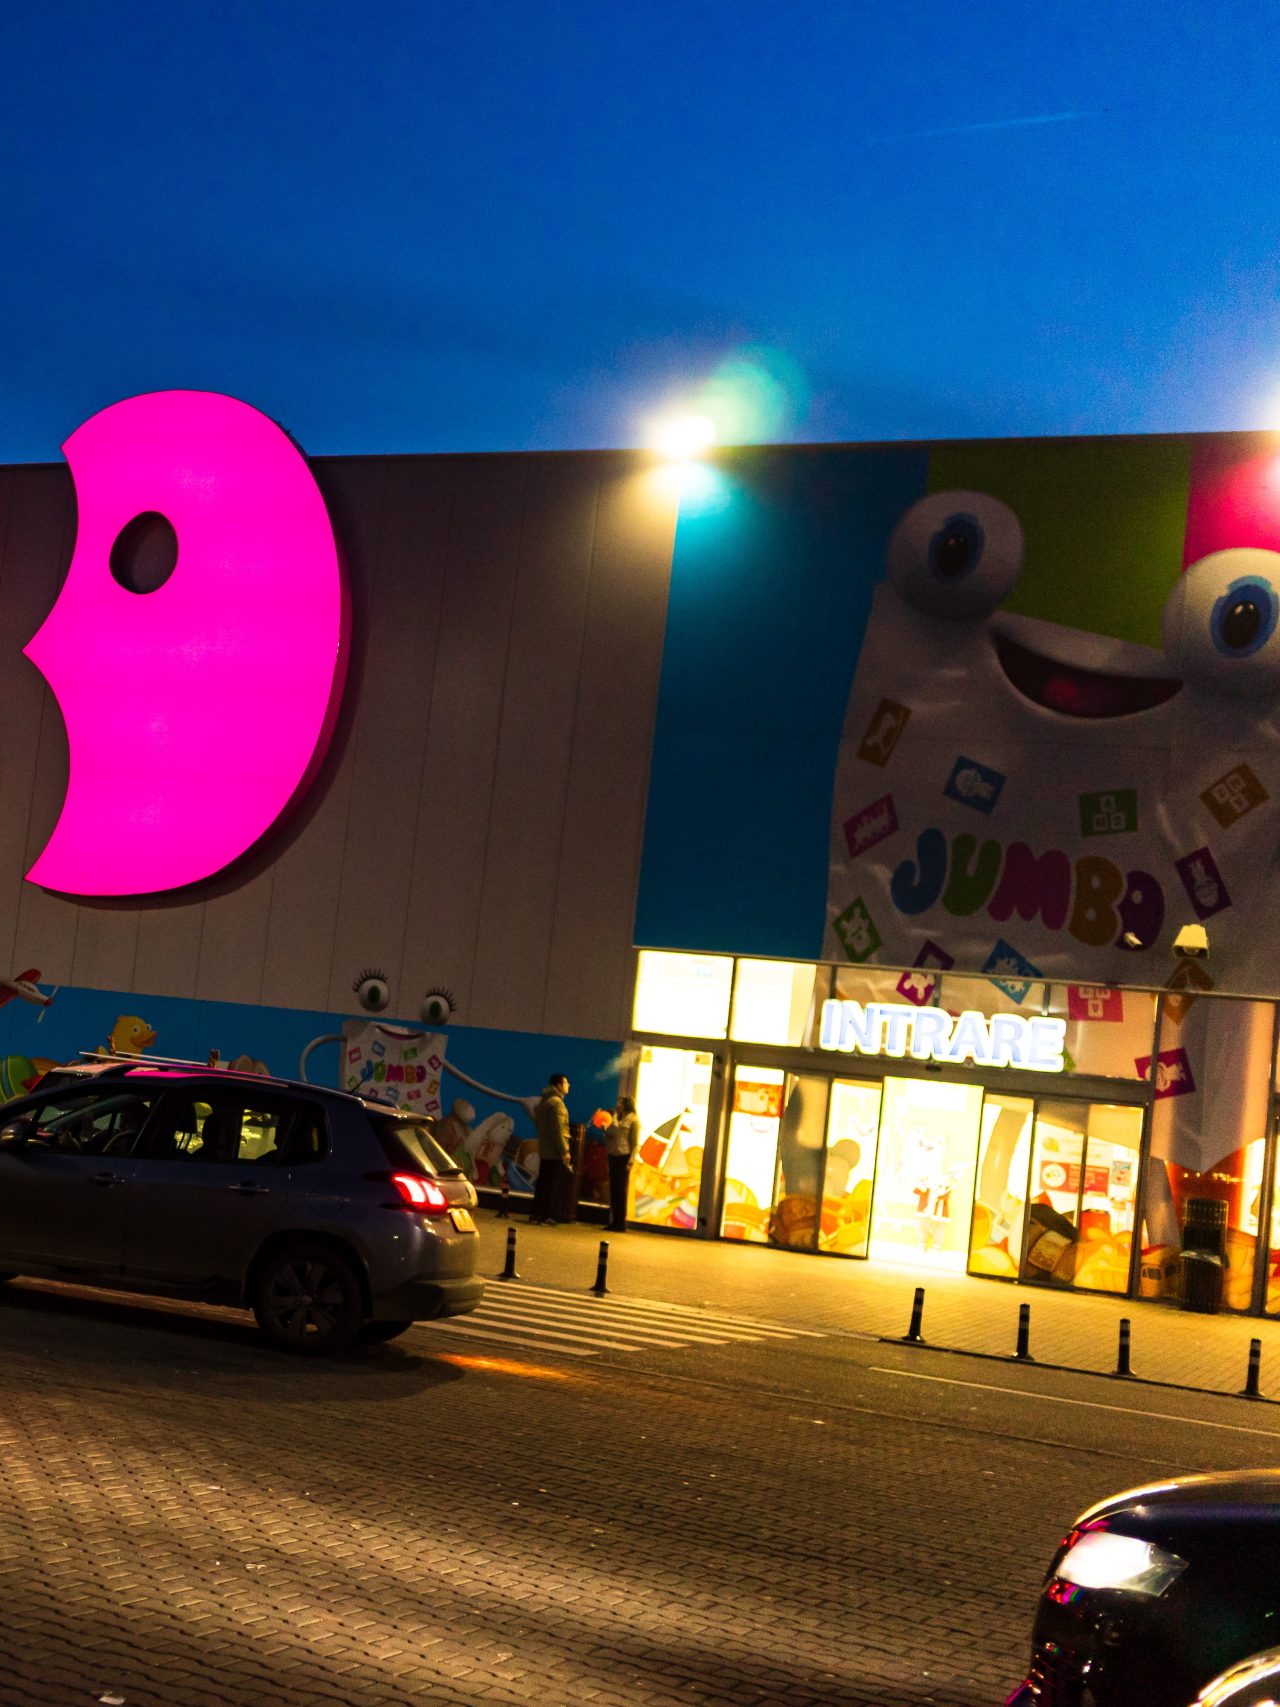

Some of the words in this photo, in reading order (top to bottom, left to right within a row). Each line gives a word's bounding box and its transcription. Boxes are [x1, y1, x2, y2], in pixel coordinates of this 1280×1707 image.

[890, 828, 1165, 951] JUMBO
[360, 1059, 427, 1084] JUMBO
[820, 999, 1066, 1072] INTRARE
